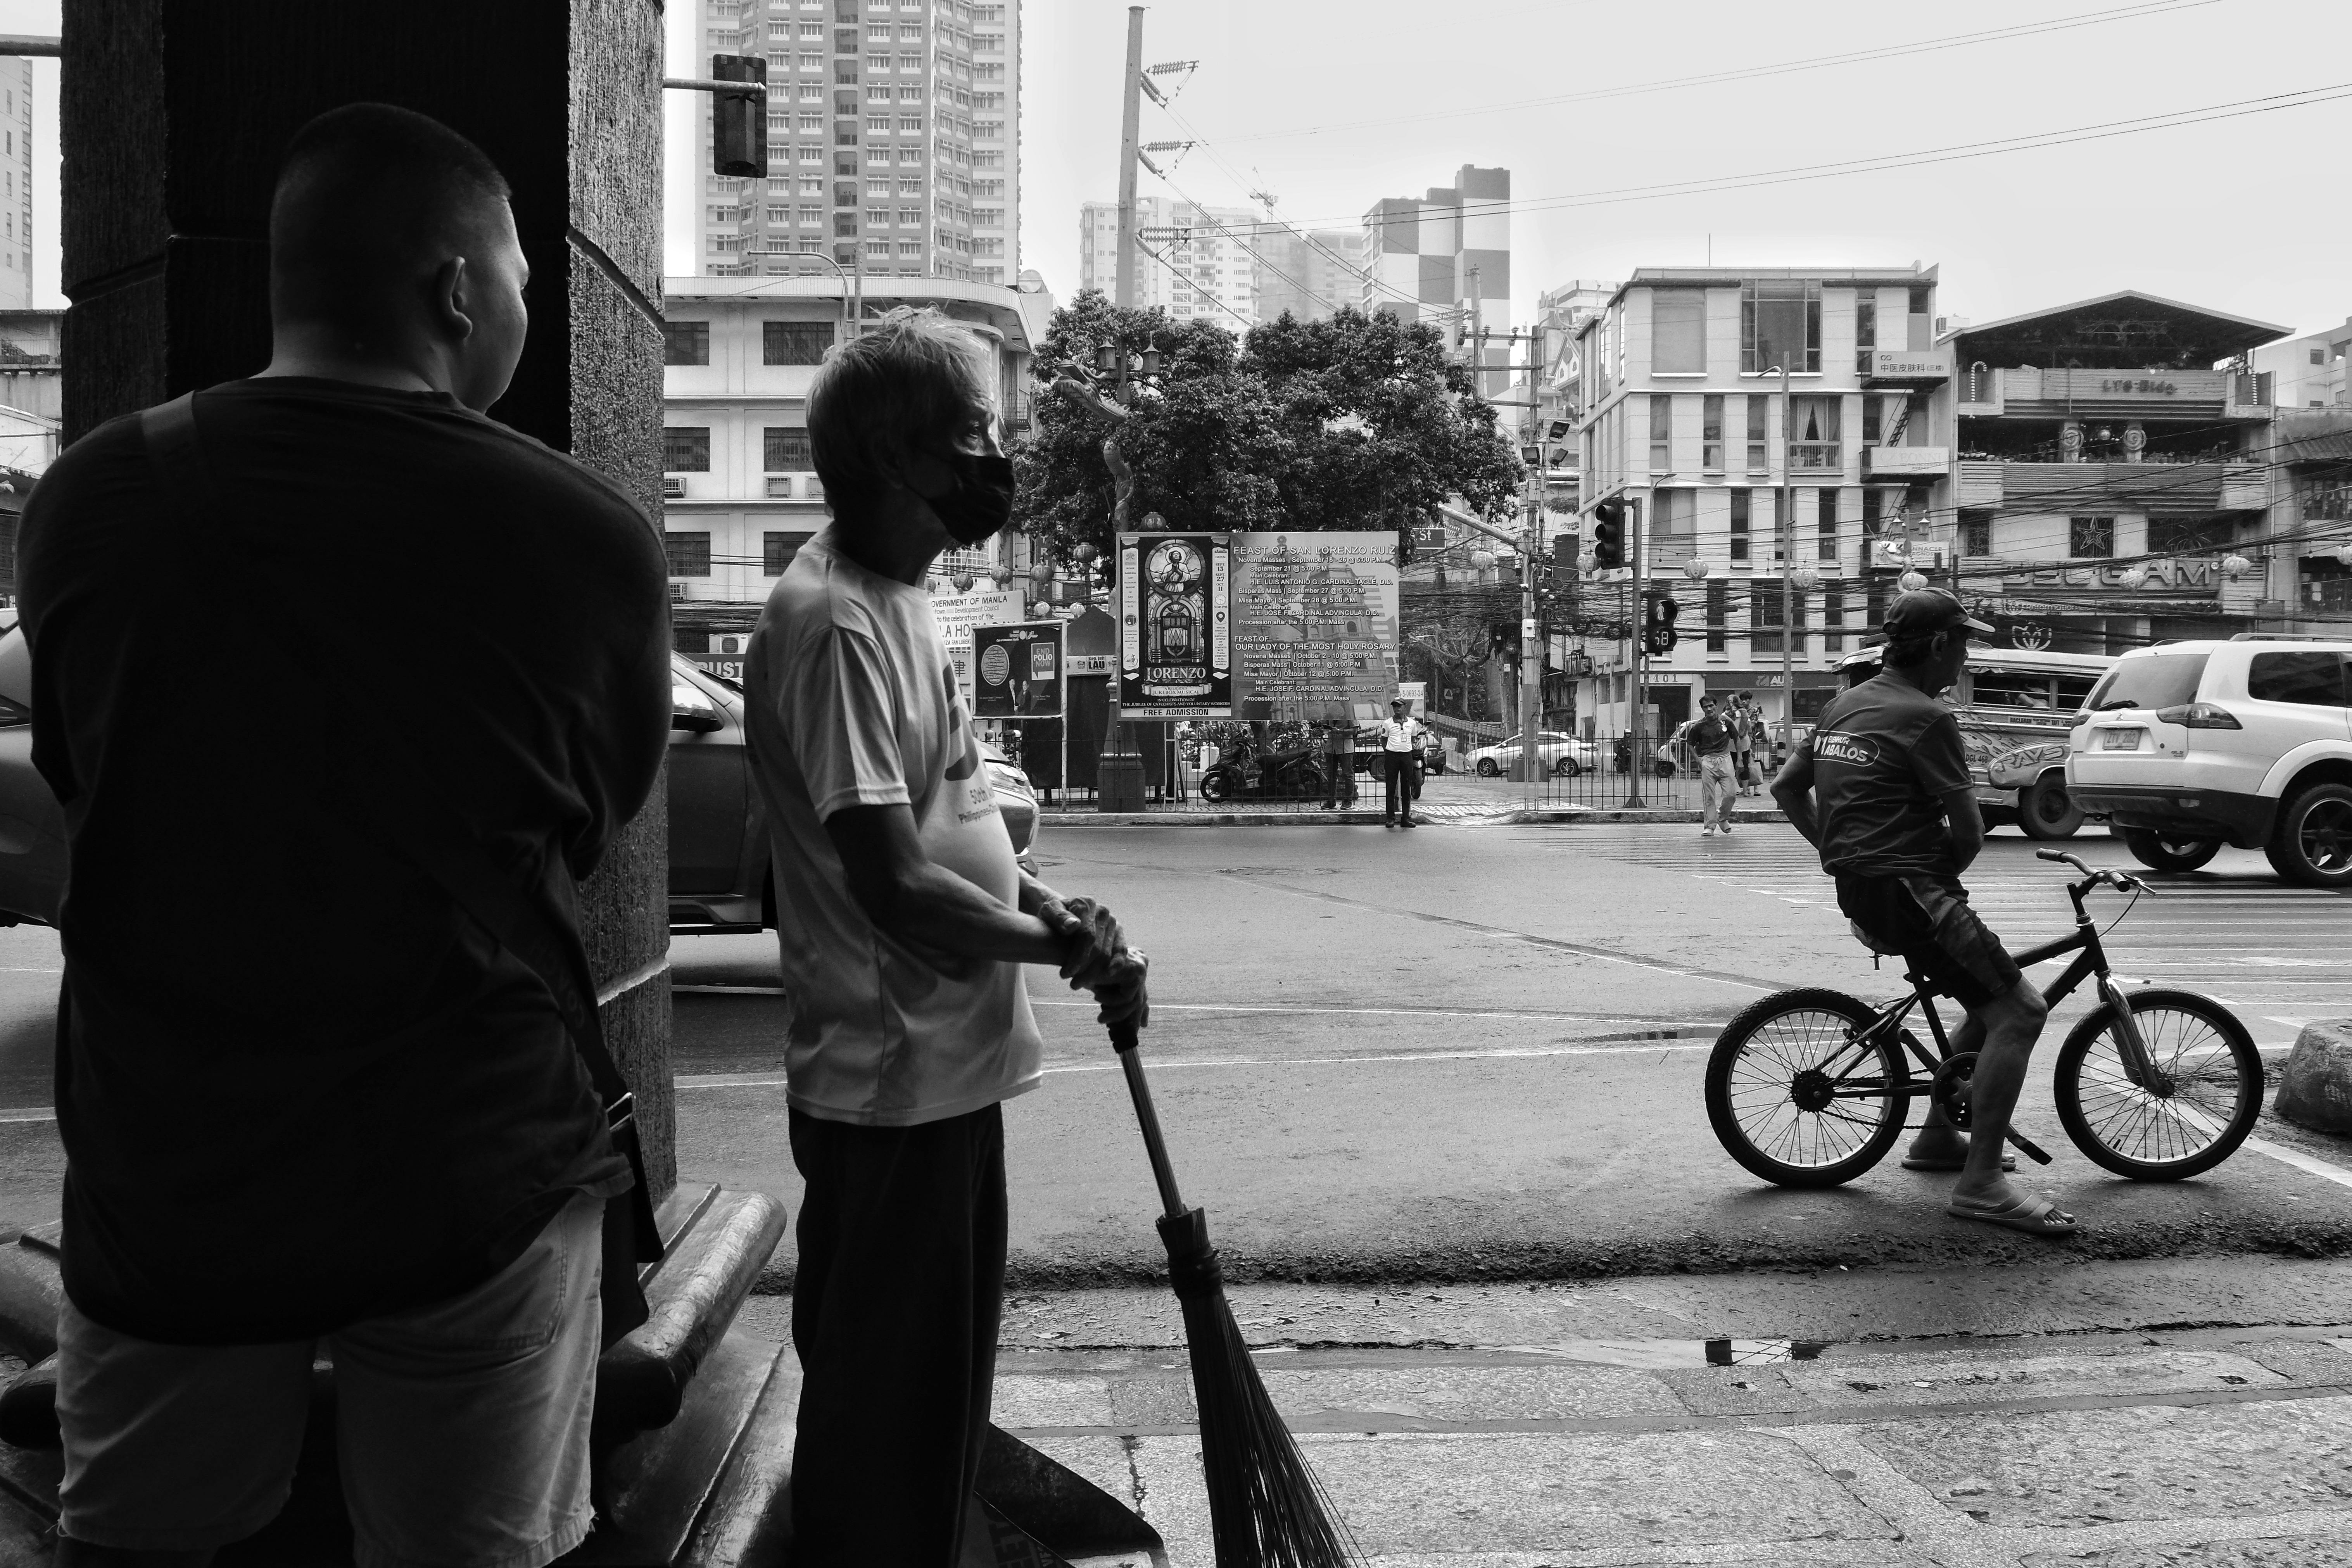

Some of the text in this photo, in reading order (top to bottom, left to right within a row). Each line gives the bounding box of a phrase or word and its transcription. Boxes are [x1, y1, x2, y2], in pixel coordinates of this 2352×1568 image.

[1419, 530, 1431, 541] St
[982, 596, 1007, 604] MANILA
[955, 605, 983, 613] Development
[1146, 667, 1206, 682] LORENZO
[1653, 673, 1678, 682] 401
[1824, 744, 1868, 762] ABALOS
